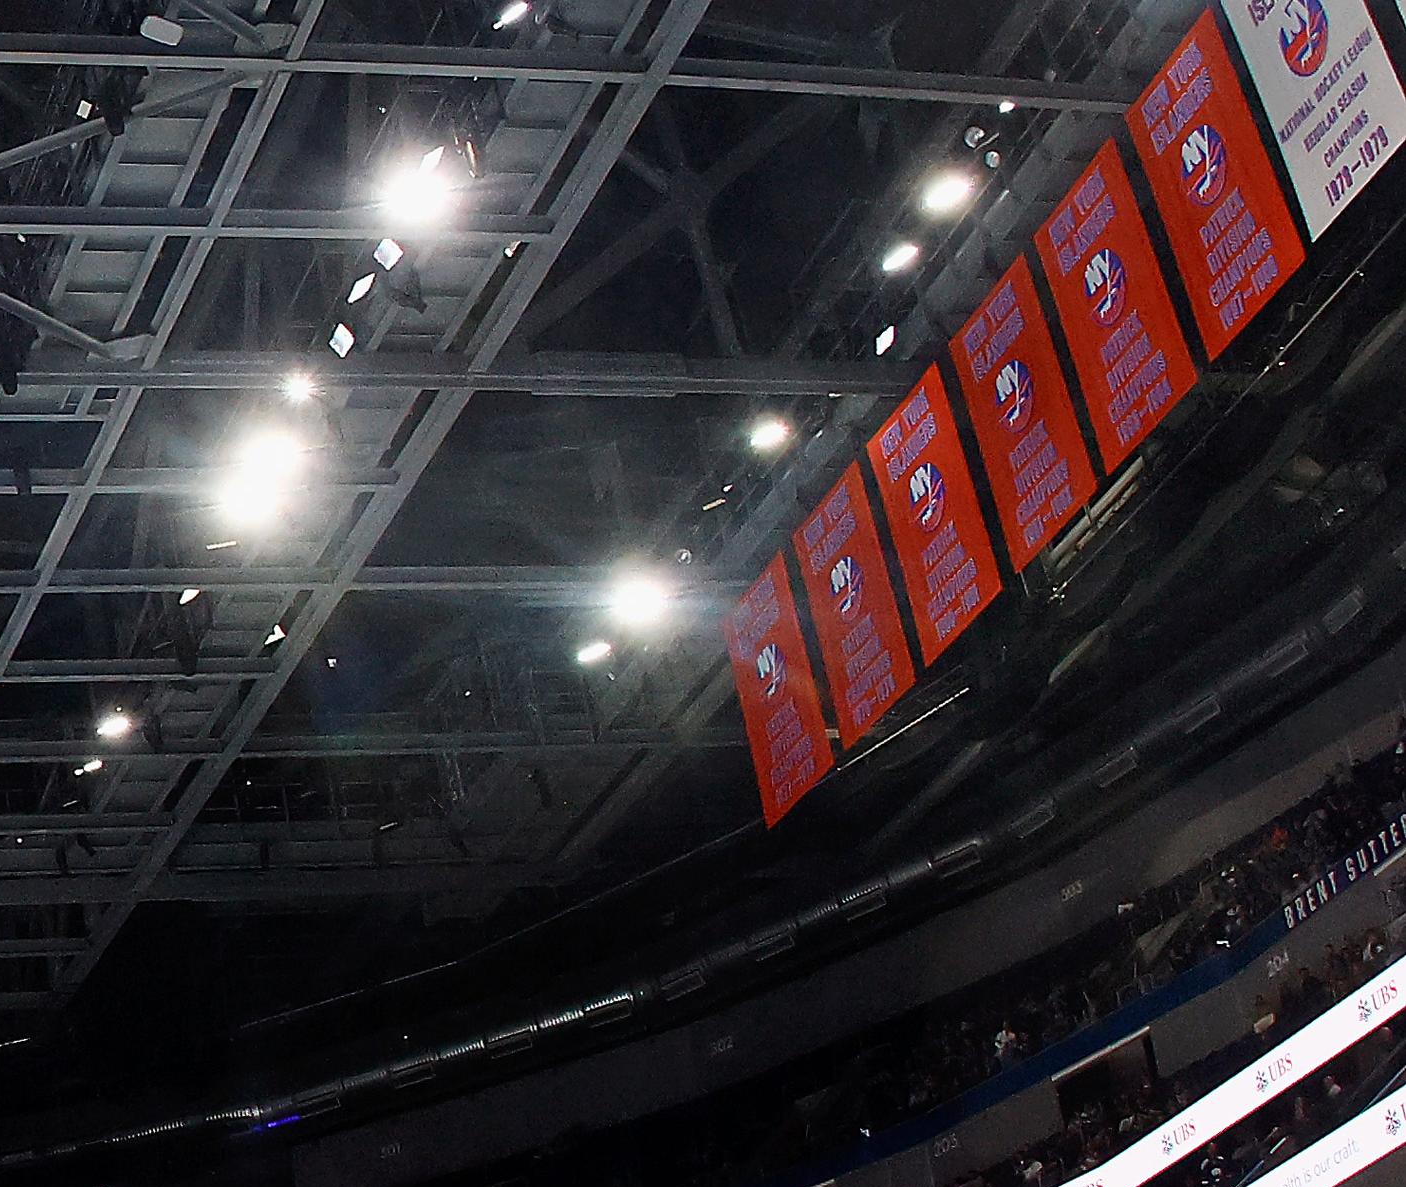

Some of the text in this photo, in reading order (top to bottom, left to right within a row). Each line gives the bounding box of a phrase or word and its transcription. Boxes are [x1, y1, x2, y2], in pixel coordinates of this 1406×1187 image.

[1284, 871, 1337, 929] BRENT
[1370, 980, 1399, 1011] UBS
[1266, 1053, 1293, 1081] UBS
[1171, 1119, 1197, 1147] UBS
